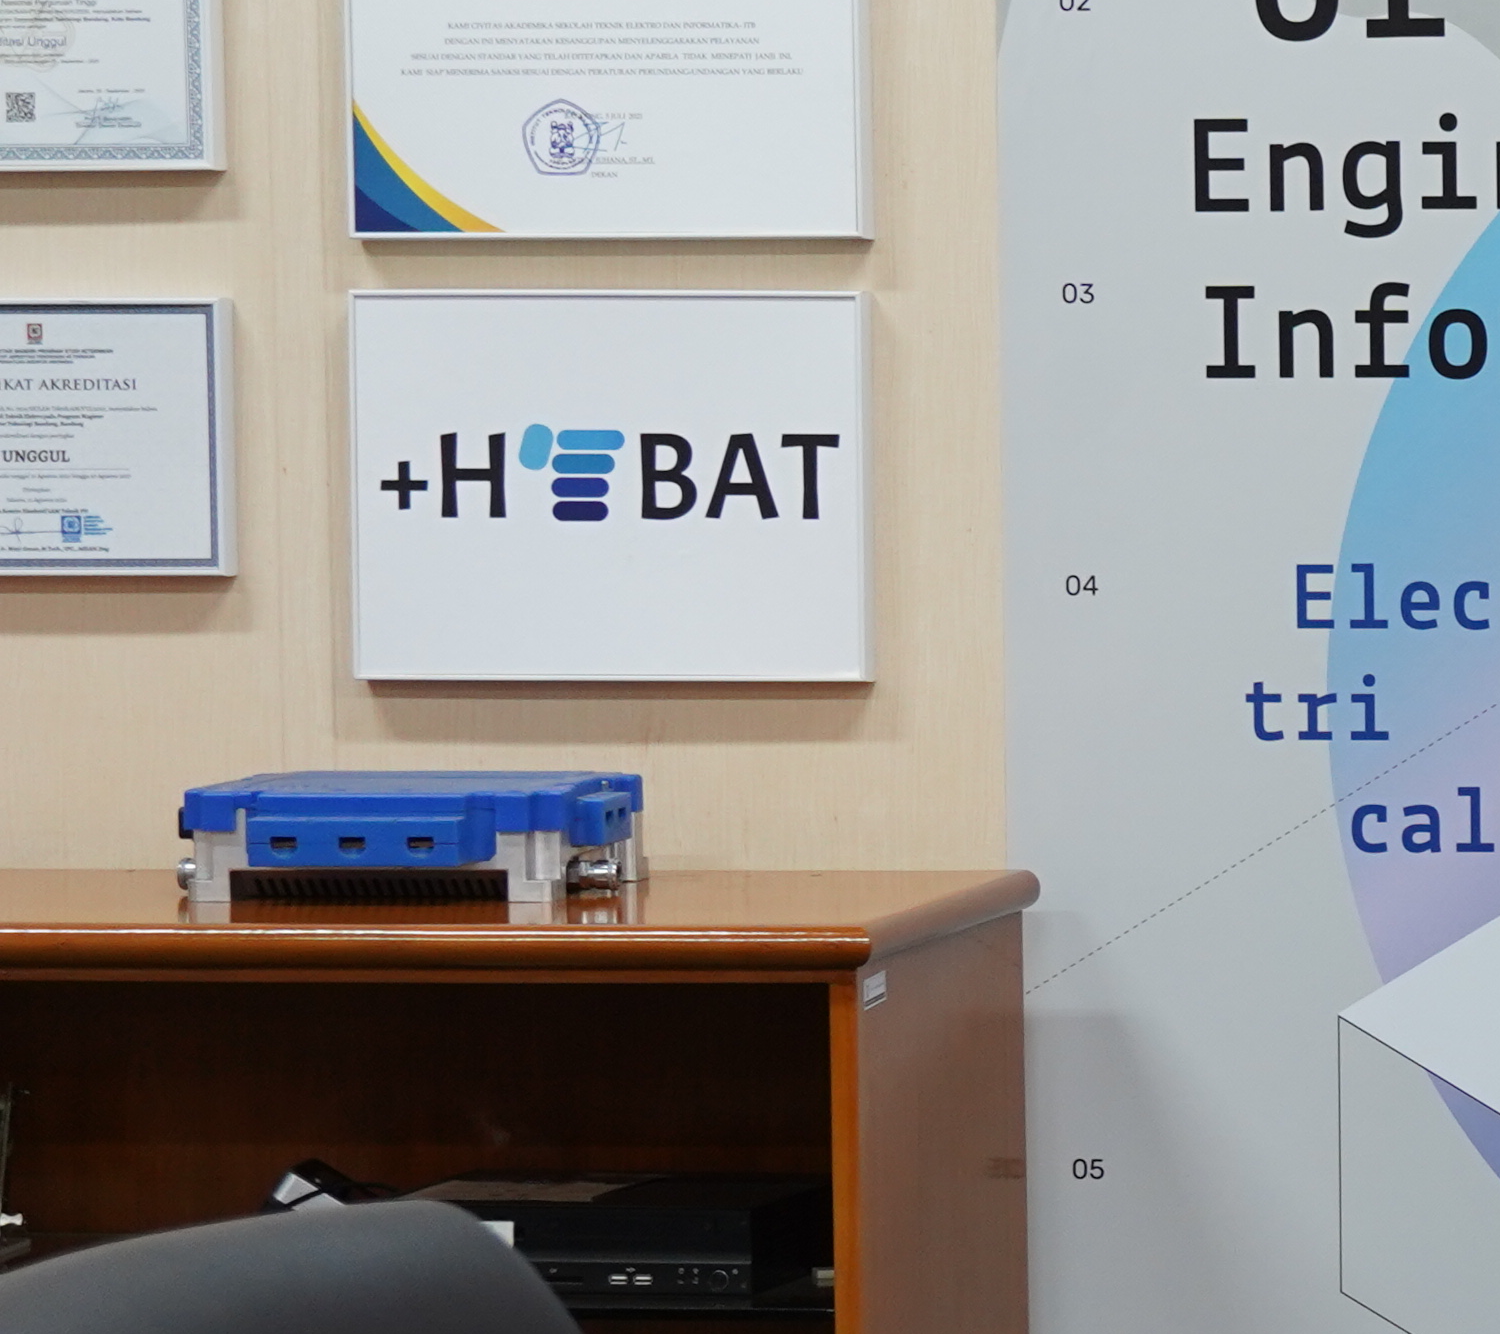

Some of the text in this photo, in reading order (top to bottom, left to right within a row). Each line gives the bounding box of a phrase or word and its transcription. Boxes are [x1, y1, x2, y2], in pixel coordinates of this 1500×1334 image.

[1062, 282, 1095, 305] 03
[38, 378, 137, 391] AKREDITASI
[2, 449, 71, 463] UNGGUL
[1065, 574, 1099, 597] 04
[1244, 672, 1391, 743] tri
[1350, 786, 1495, 854] cal
[1072, 1158, 1105, 1180] 05
